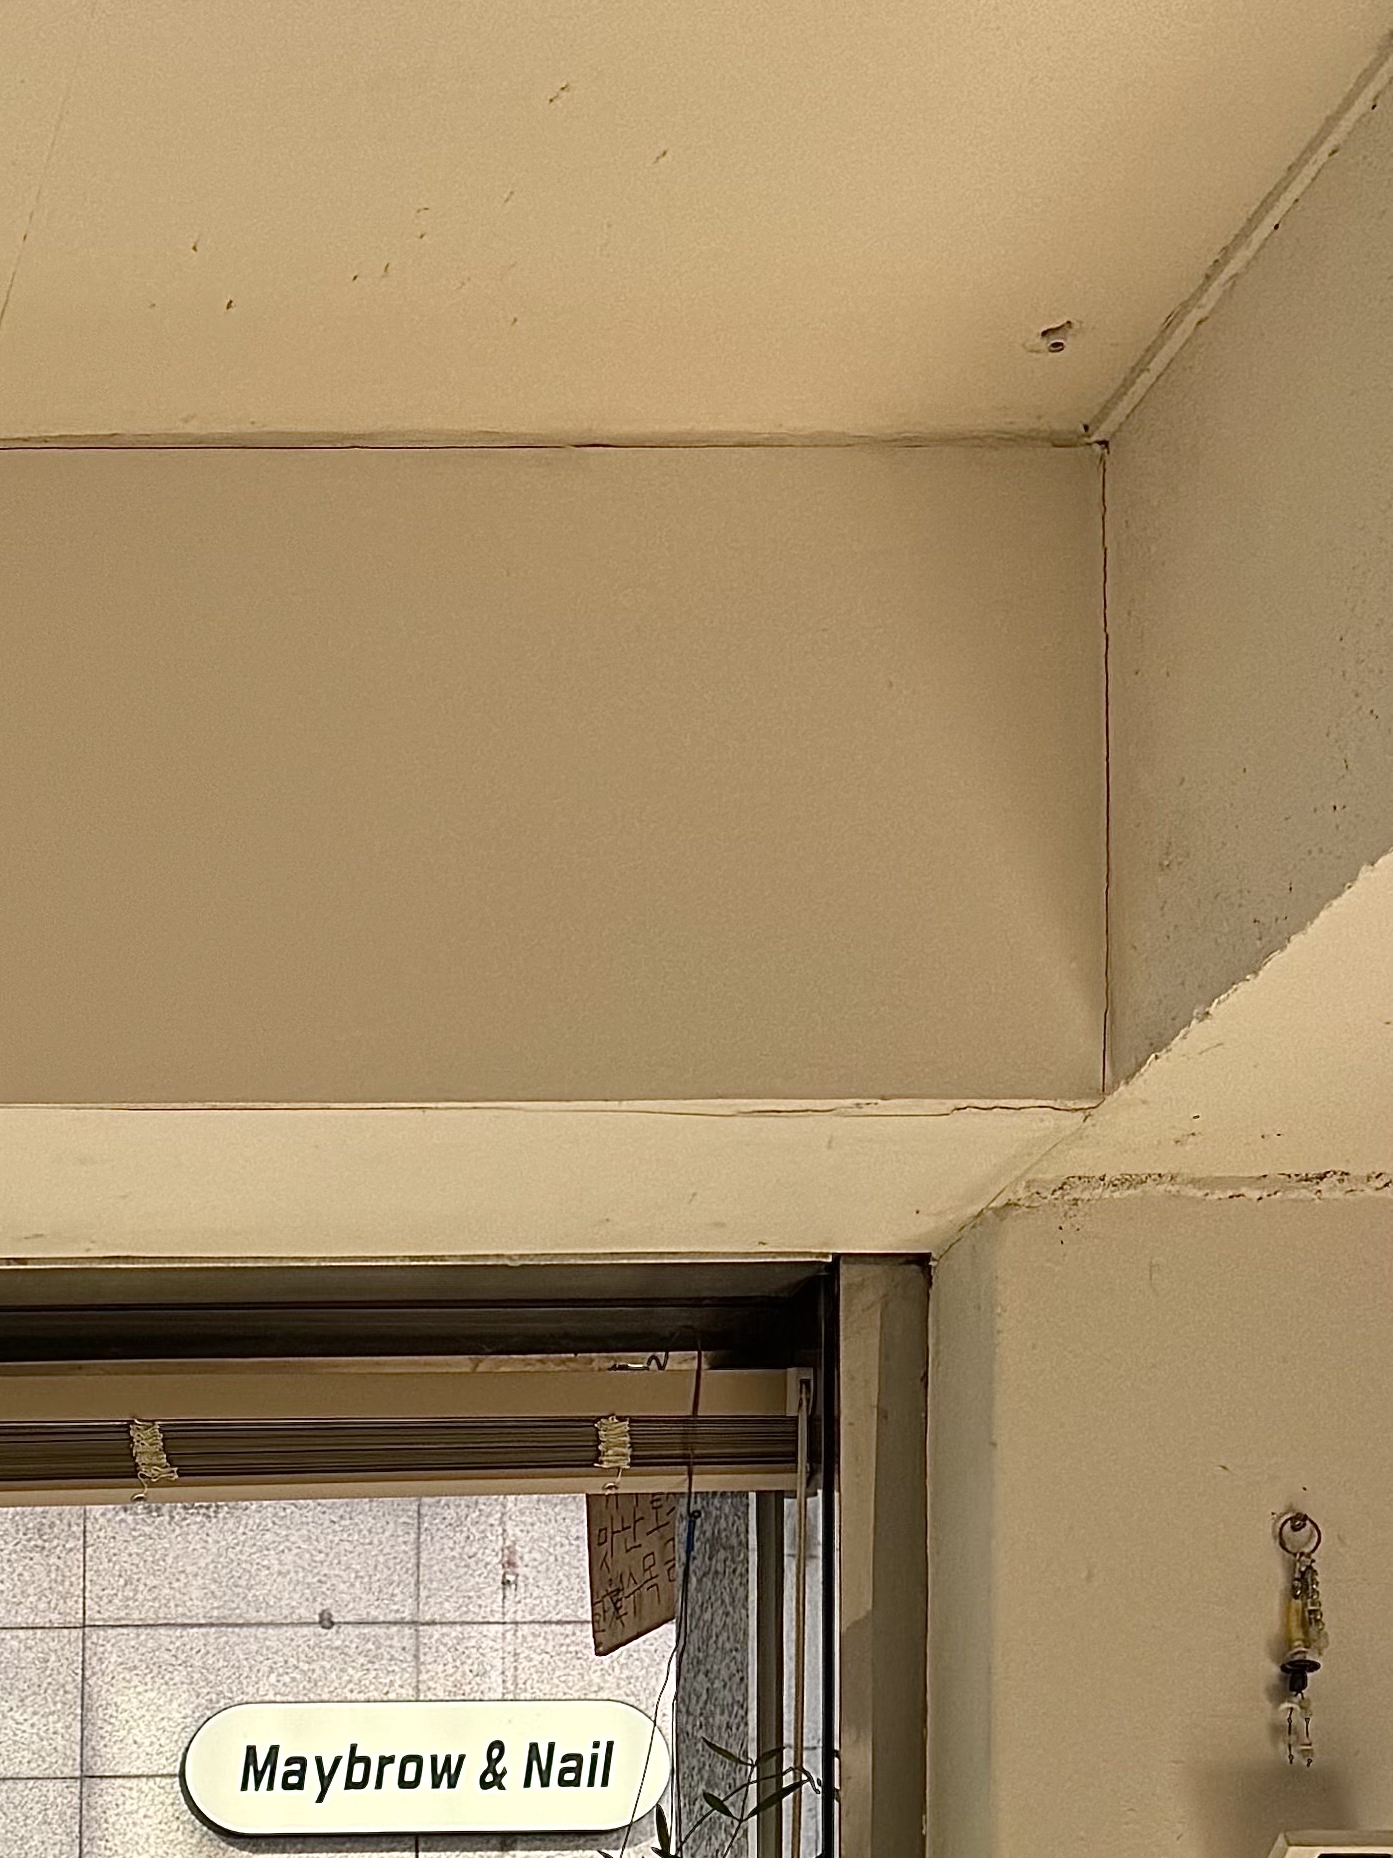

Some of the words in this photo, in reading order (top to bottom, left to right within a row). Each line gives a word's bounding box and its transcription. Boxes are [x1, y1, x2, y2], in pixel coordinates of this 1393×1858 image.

[240, 1743, 466, 1803] Maybrow
[479, 1739, 508, 1791] &
[523, 1740, 615, 1789] Nail
